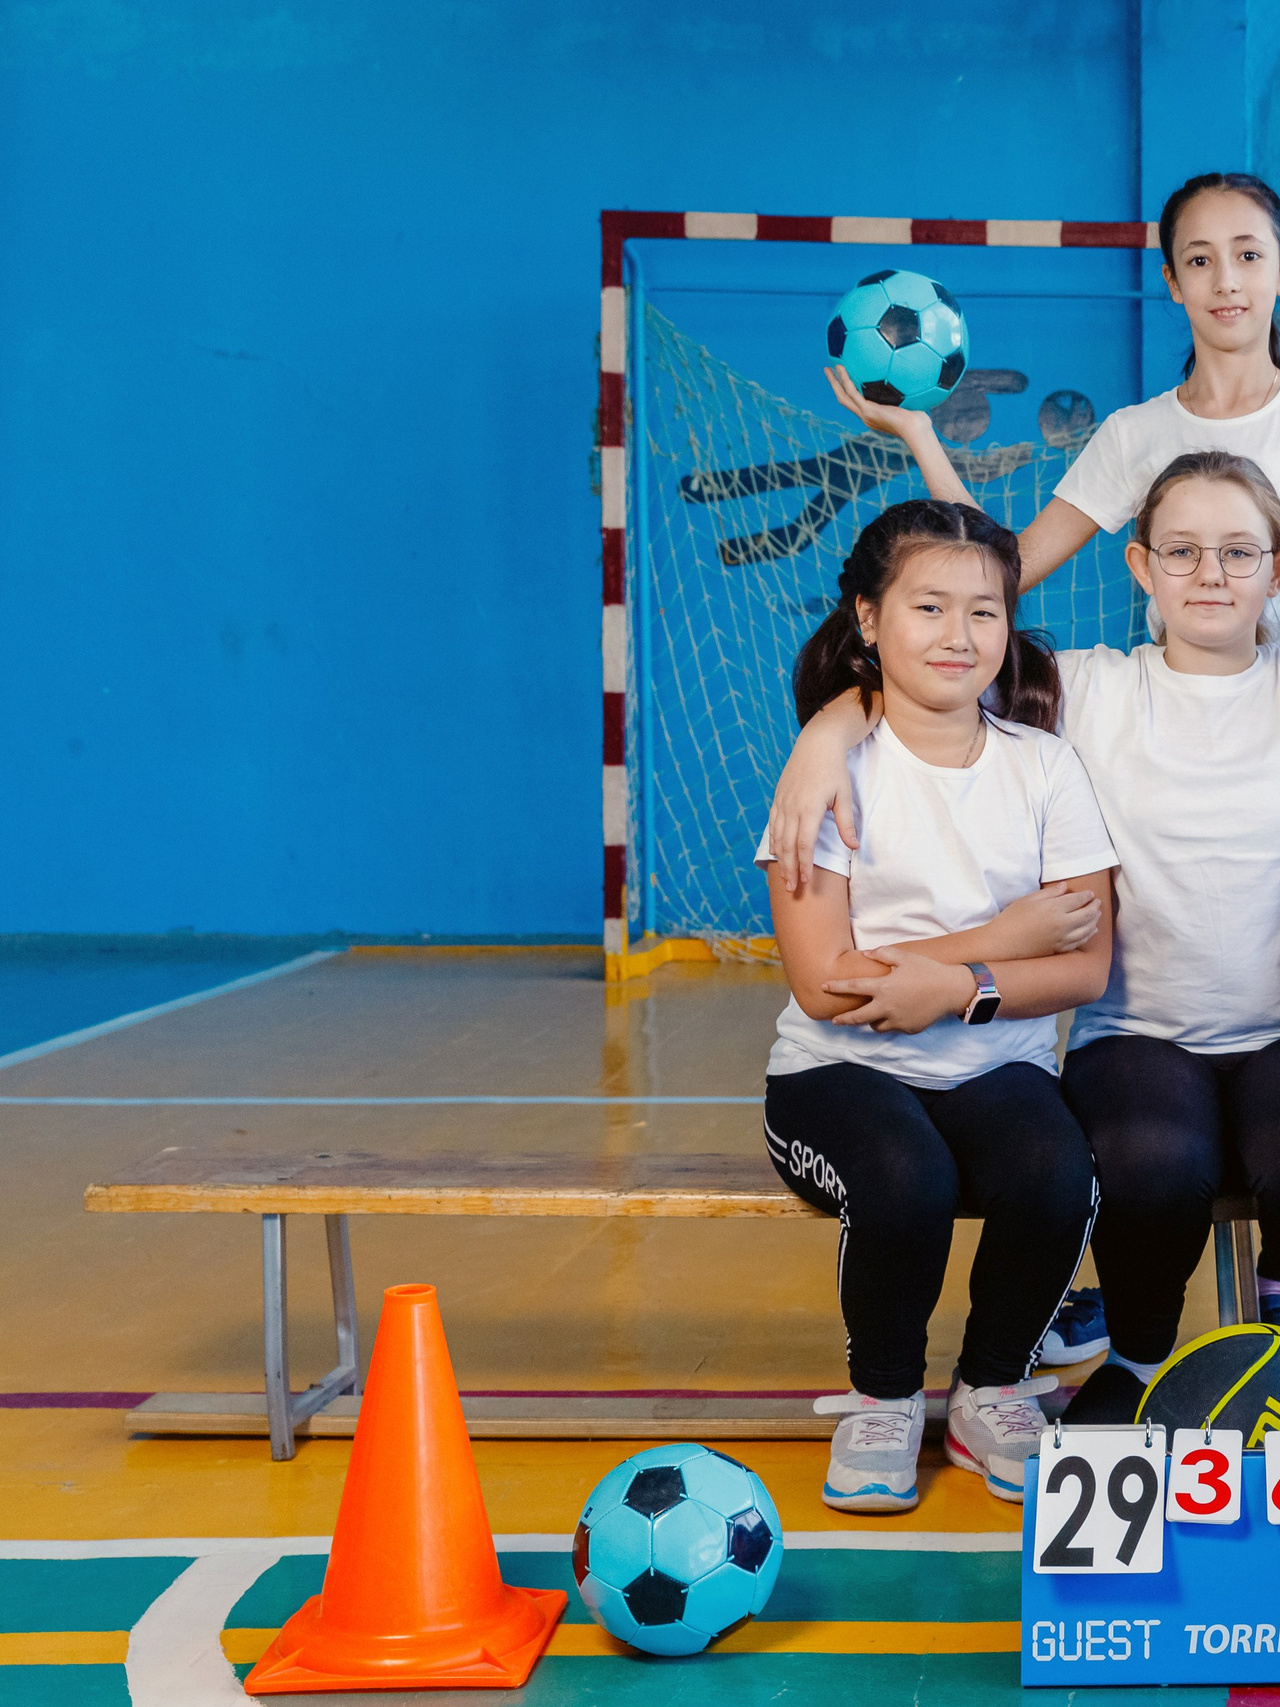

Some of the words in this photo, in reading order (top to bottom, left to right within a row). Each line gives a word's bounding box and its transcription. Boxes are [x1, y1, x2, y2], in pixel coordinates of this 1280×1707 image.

[1039, 1455, 1159, 1568] 29
[1174, 1448, 1232, 1516] 3
[1031, 1619, 1162, 1662] GUEST
